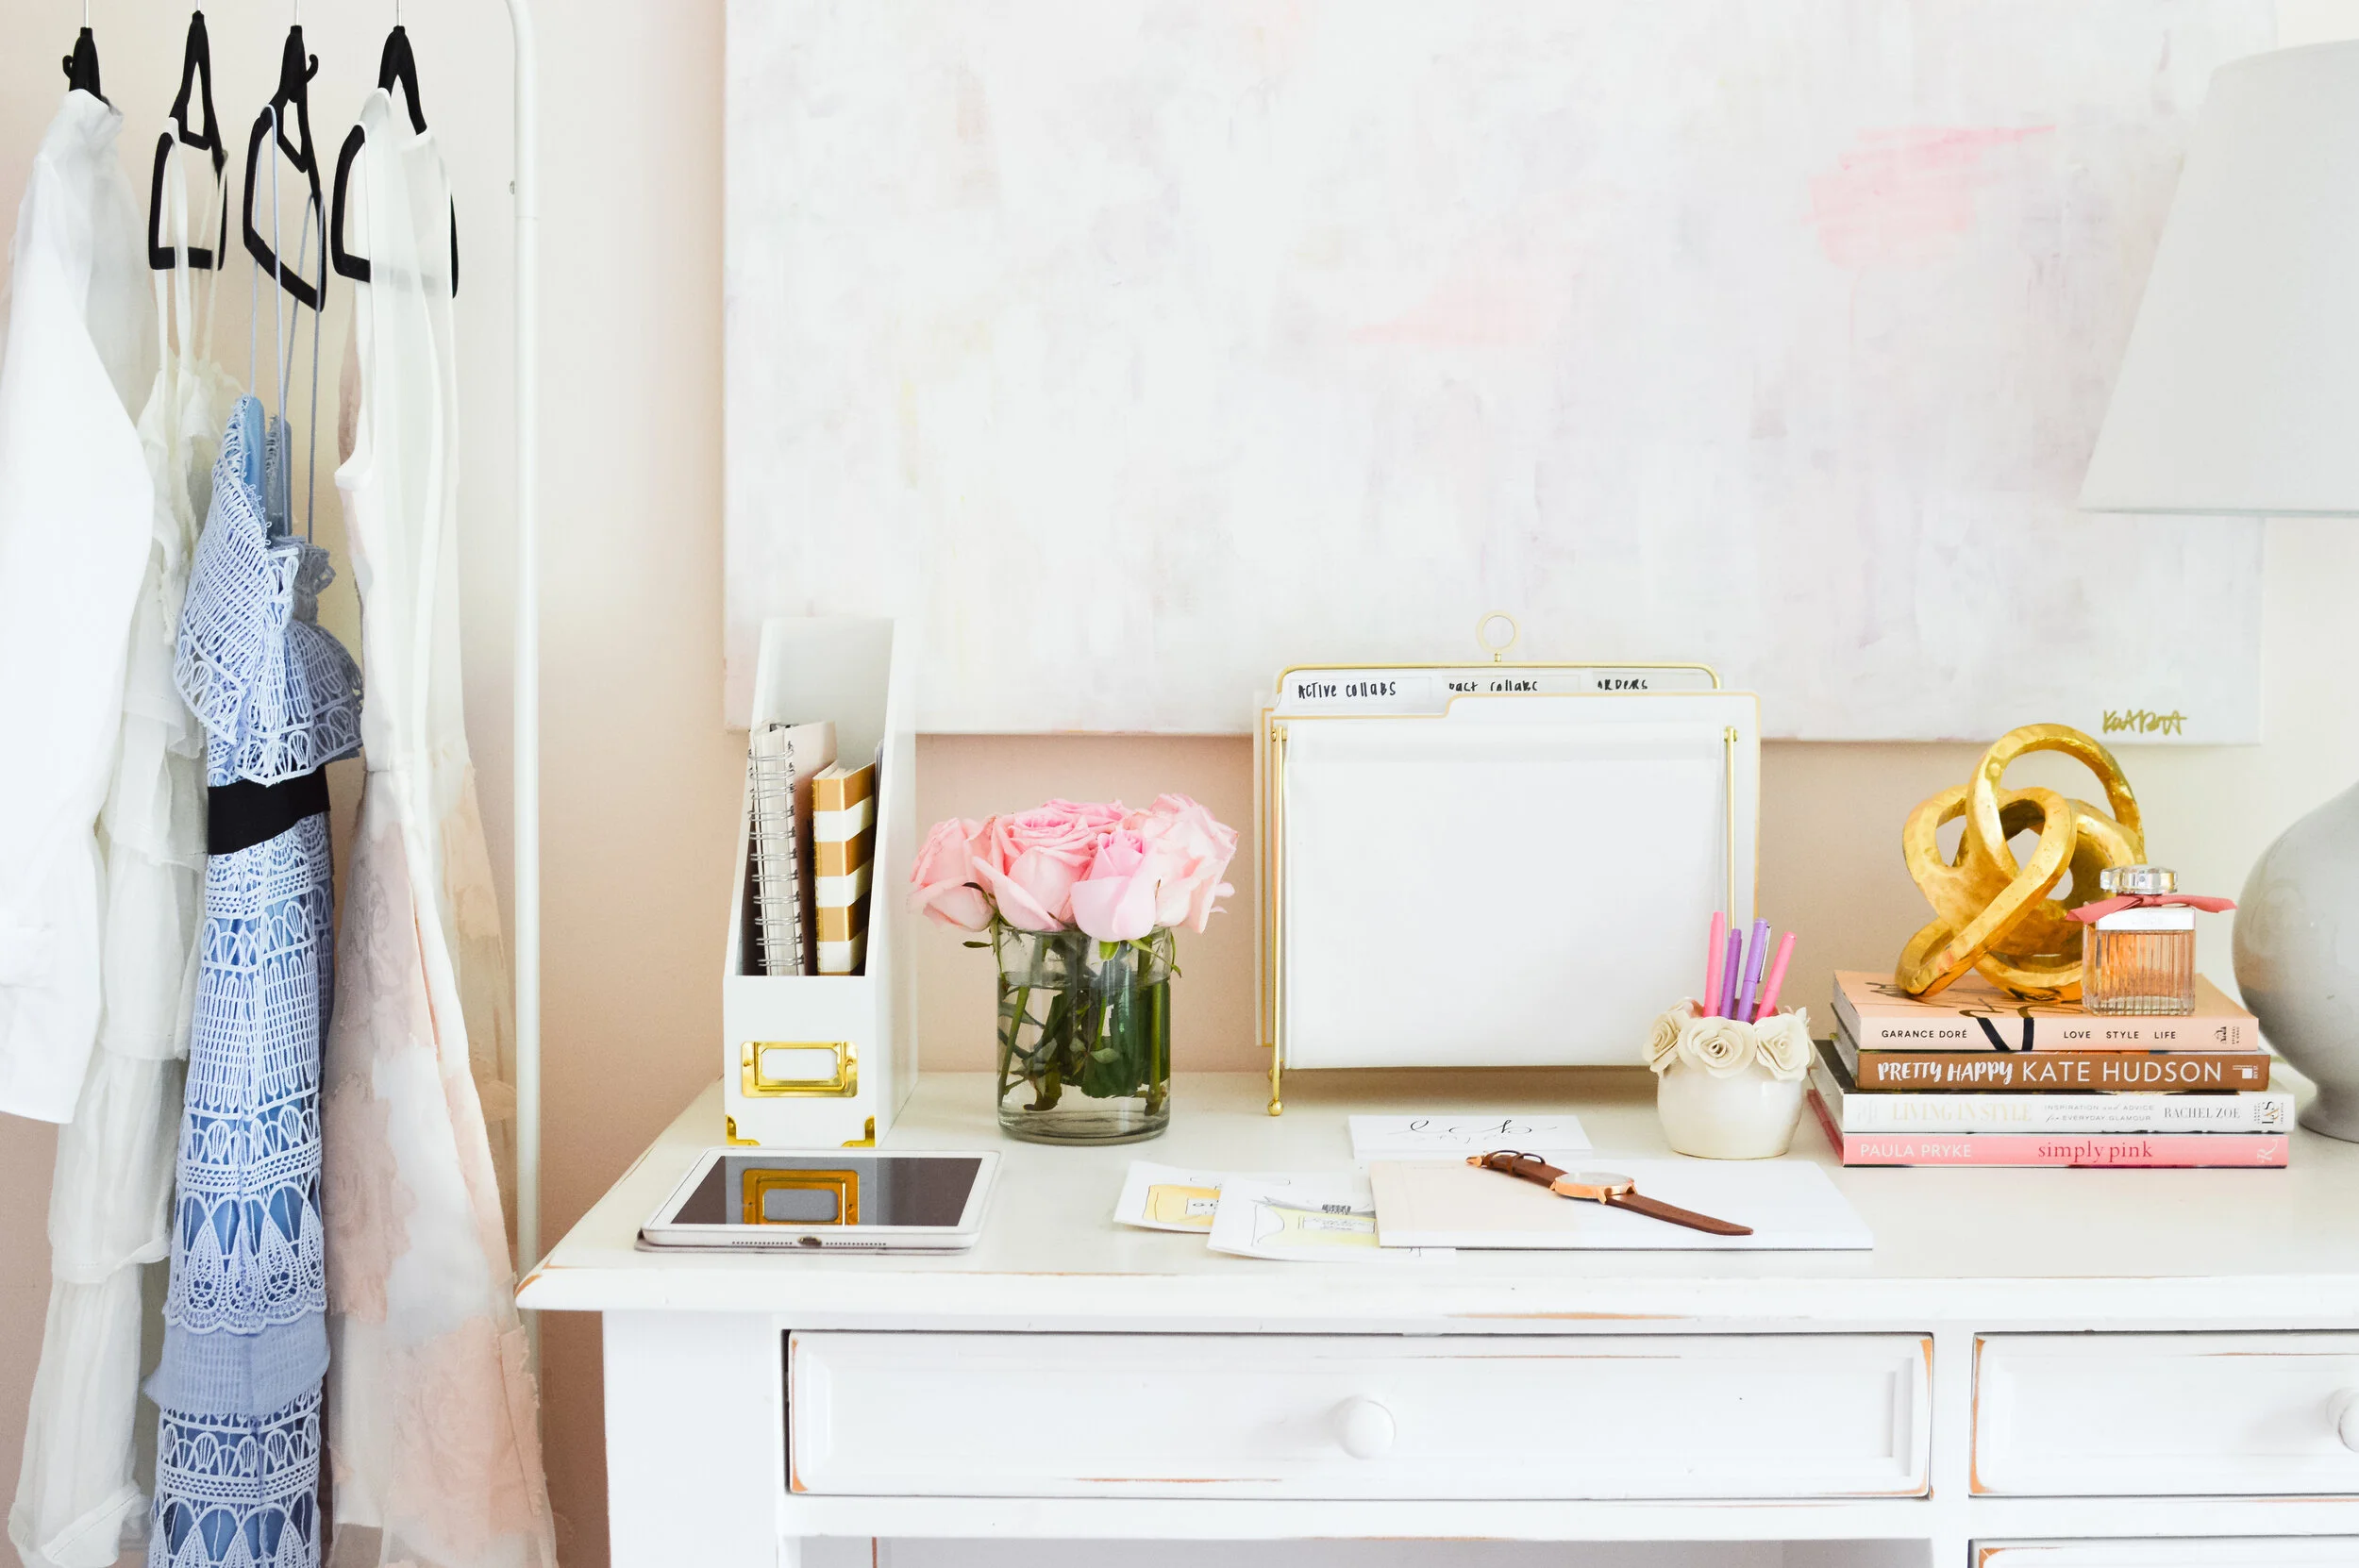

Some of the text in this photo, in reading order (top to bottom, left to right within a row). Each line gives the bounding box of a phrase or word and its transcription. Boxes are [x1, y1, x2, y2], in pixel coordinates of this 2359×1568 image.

[1881, 1028, 1968, 1039] GARANCE DORÉ
[2063, 1030, 2177, 1040] LOVE STYLE LIFE
[1877, 1060, 2014, 1085] PRETTY HAPPY
[2022, 1061, 2091, 1082] KATE
[2102, 1061, 2222, 1082] HUDSON
[1892, 1102, 1952, 1122] LIVING
[1957, 1102, 1977, 1121] IN
[1980, 1102, 2033, 1122] STYLE
[2164, 1108, 2214, 1120] RACHEL
[2215, 1108, 2241, 1120] ZOE
[1860, 1143, 1972, 1158] PAULA PRYKE
[2037, 1140, 2154, 1163] simply pink
